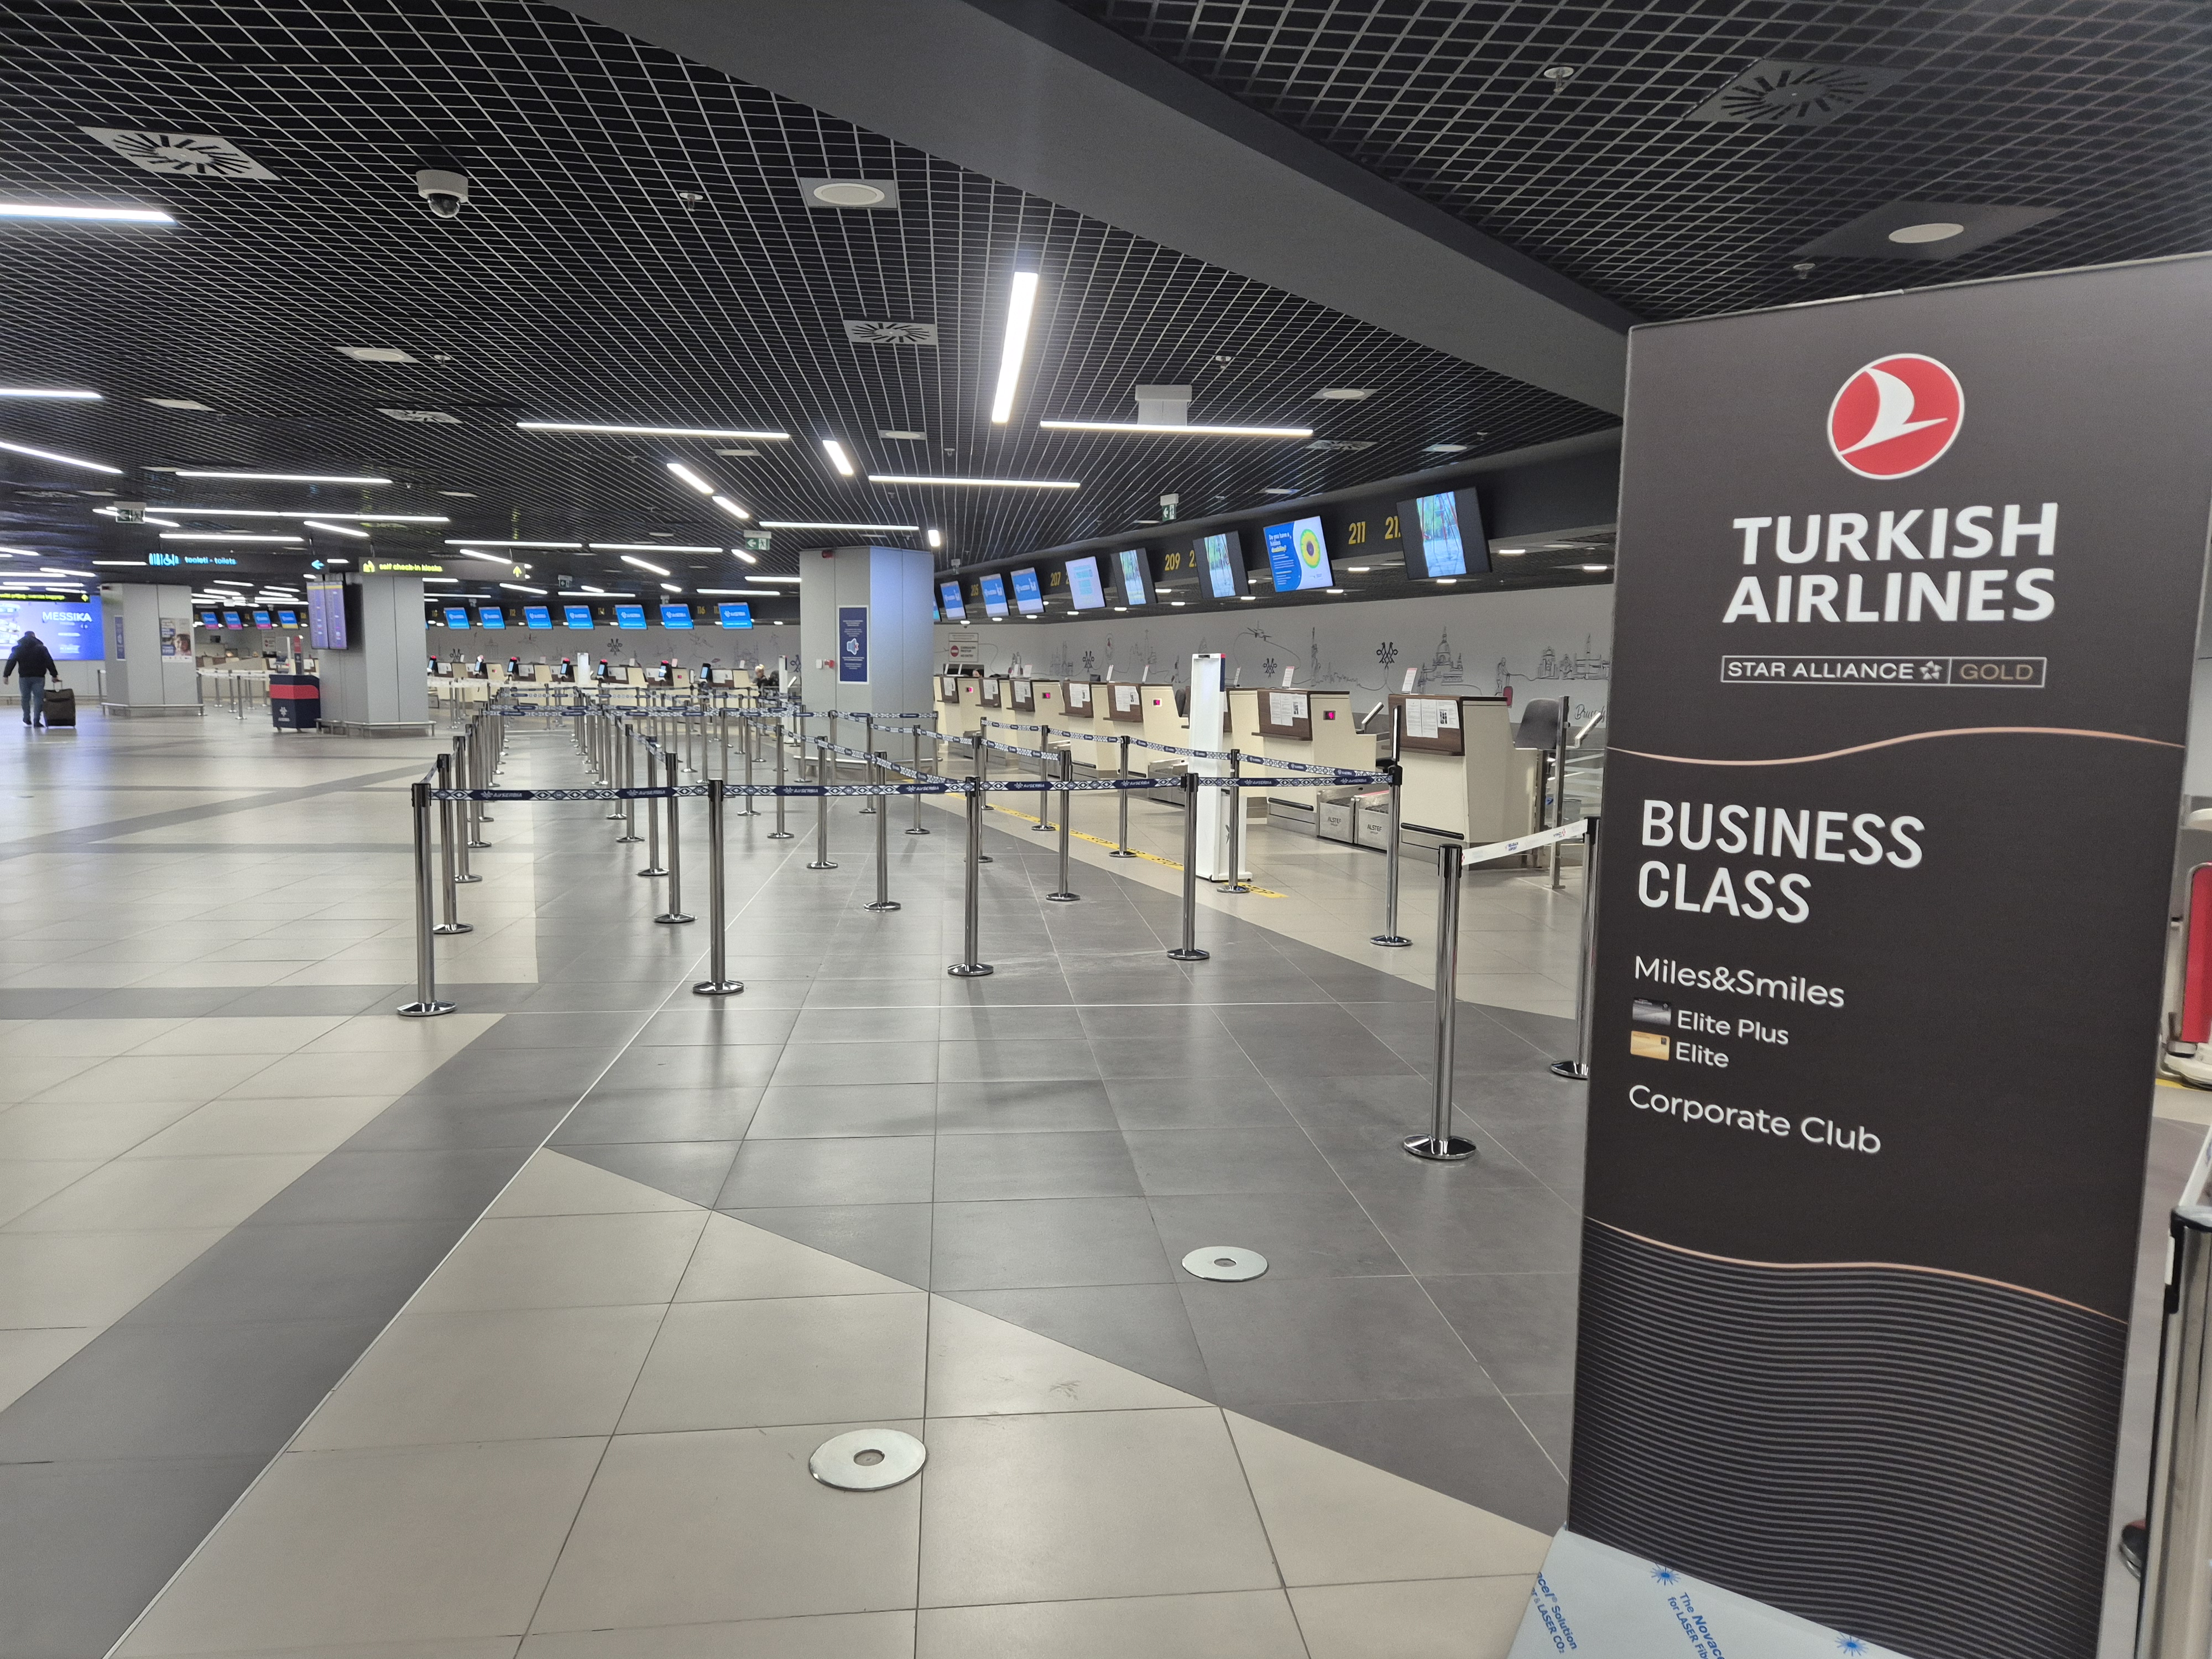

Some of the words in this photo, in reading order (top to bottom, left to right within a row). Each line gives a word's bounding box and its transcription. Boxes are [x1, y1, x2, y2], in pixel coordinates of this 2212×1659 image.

[1348, 521, 1366, 545] 211
[1385, 515, 1401, 540] 21
[1733, 503, 2058, 565] TURKISH
[1165, 552, 1181, 571] 209
[1050, 572, 1061, 587] 207
[1722, 568, 2055, 623] AIRLINES
[43, 612, 92, 622] MESSIKA
[697, 606, 706, 614] 116
[1728, 661, 1786, 677] STAR
[1792, 662, 1914, 679] ALLIANCE
[1959, 664, 2033, 680] GOLD
[1642, 800, 1925, 869] BUSINESS
[1639, 860, 1812, 924] CLASS
[1635, 956, 1845, 1008] Miles&Smiles
[1678, 1010, 1731, 1035] Elite
[1738, 1019, 1790, 1045] Plus
[1676, 1041, 1729, 1068] Elite
[1629, 1085, 1791, 1136] Corporate
[1801, 1117, 1881, 1154] Club
[1537, 1604, 1557, 1635] LASER
[1552, 1605, 1577, 1650] Solution
[1668, 1597, 1680, 1610] for
[1676, 1611, 1699, 1643] LASER
[1694, 1643, 1709, 1659] Fib
[1679, 1592, 1694, 1613] The
[1692, 1615, 1725, 1659] Novac
